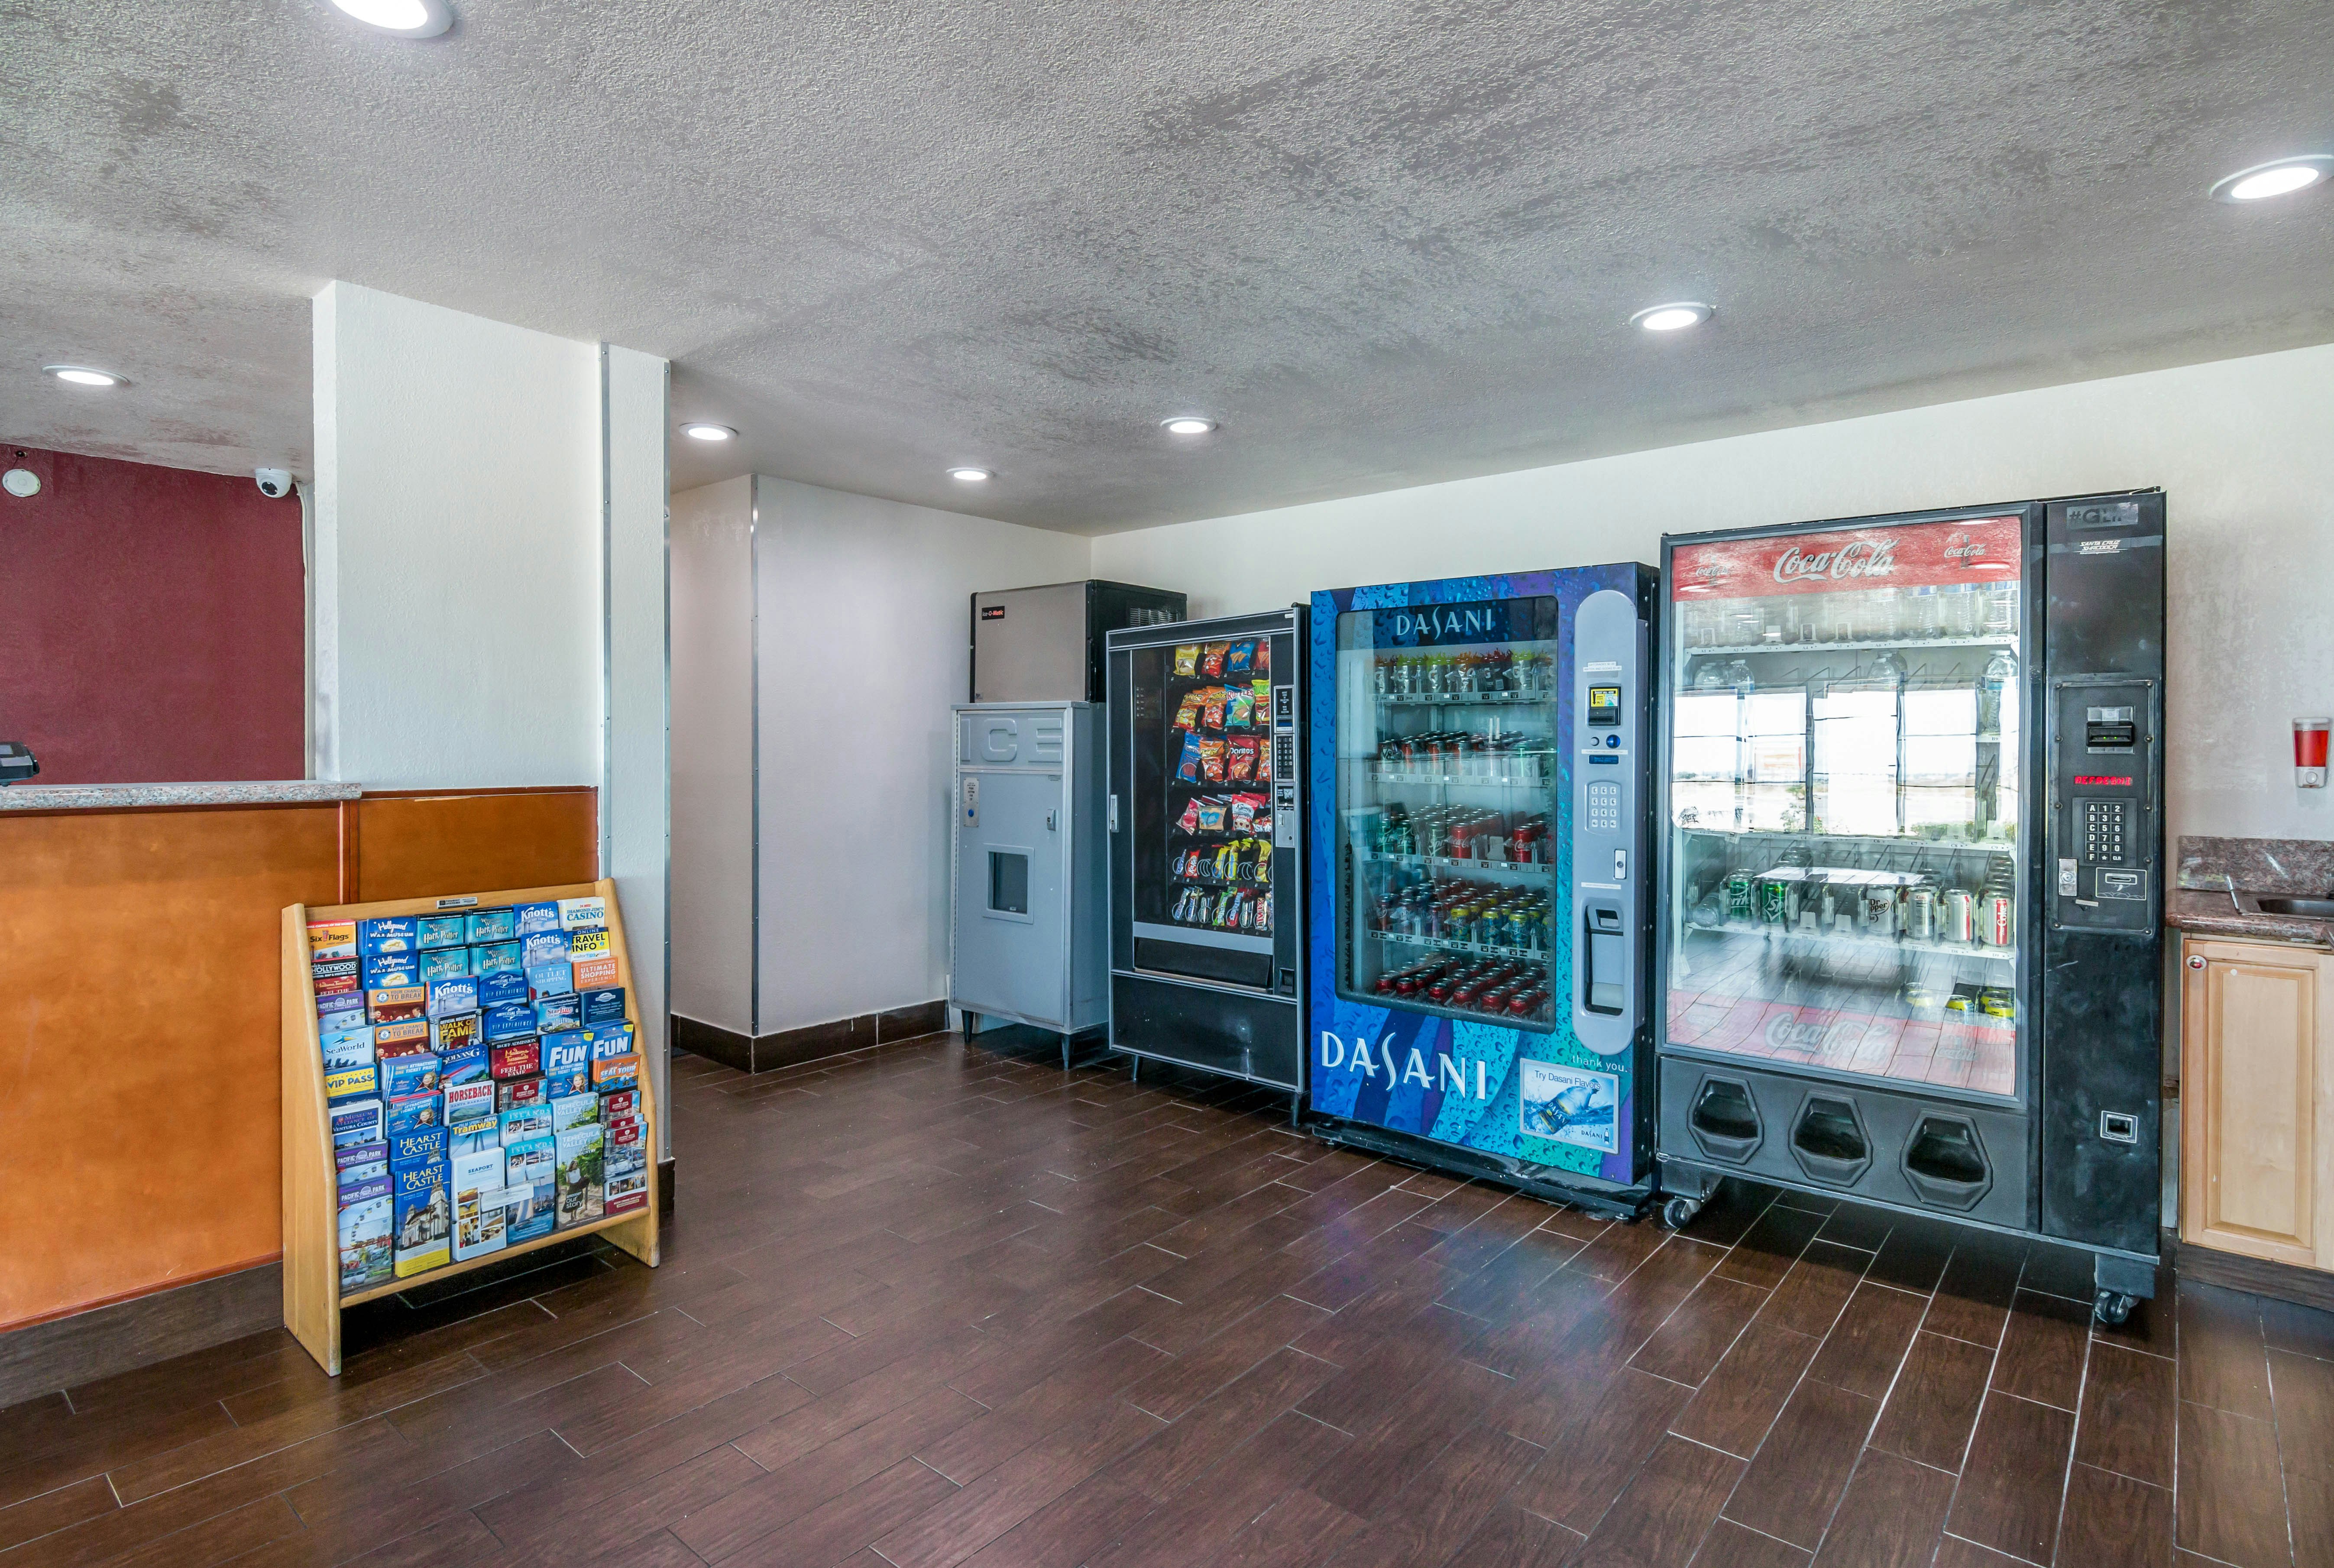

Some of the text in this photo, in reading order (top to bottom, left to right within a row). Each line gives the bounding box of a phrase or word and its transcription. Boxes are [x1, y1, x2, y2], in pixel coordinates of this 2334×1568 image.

[1944, 544, 1986, 557] Coca-Cola
[1773, 538, 1900, 583] Coca-Cola
[1396, 606, 1492, 639] DASANI
[961, 718, 1062, 762] ICE
[521, 906, 554, 922] Knott's
[567, 911, 603, 921] CASINO
[1997, 904, 2008, 927] Coke
[378, 920, 408, 933] Hollywood
[476, 925, 509, 938] Harry Potter
[424, 930, 458, 944] Harry Potter
[526, 933, 561, 950] Knott's
[572, 933, 605, 944] TRAVEL
[572, 943, 596, 952] INFO
[312, 963, 356, 973] HOLLYWOOD
[378, 956, 409, 968] Hollywood
[482, 956, 516, 970] Harry Potter
[581, 963, 615, 973] ULTIMATE
[427, 962, 463, 977] Harry Potter
[535, 970, 566, 979] OUTLET
[581, 969, 616, 979] SHOPPING
[581, 975, 615, 983] EXPERIENCE
[434, 982, 473, 999] Knott's
[496, 987, 524, 996] EXPERIENCE
[456, 1014, 476, 1022] HOLLYWOOD
[502, 1020, 532, 1029] EXPERIENCE
[440, 1021, 465, 1030] WALK
[440, 1025, 476, 1040] FAME
[326, 1042, 365, 1055] SeaWorld
[505, 1048, 529, 1057] Madame
[593, 1036, 628, 1059] FUN
[507, 1053, 529, 1062] Tussauds
[549, 1045, 587, 1067] FUN
[500, 1064, 518, 1074] FEEL
[618, 1065, 636, 1075] TOUR
[1322, 1031, 1486, 1100] DASANI
[1572, 1055, 1628, 1072] thank you.
[508, 1069, 526, 1078] FAME
[1534, 1070, 1602, 1090] Try Dasani Flavors.
[327, 1074, 374, 1089] VIP PASS
[449, 1085, 492, 1103] HORSEBACK
[557, 1098, 594, 1111] TEMECULA
[344, 1111, 372, 1121] MUSEUM
[509, 1109, 550, 1120] ISLANDS
[557, 1107, 582, 1116] VALLEY
[333, 1119, 378, 1132] VENTURA COUNTY
[453, 1119, 498, 1135] Tramway
[400, 1132, 443, 1148] HEARST
[563, 1130, 600, 1143] TEMECULA
[1581, 1130, 1602, 1139] DASANI
[403, 1141, 441, 1156] CASTLE
[511, 1140, 553, 1153] ISLANDS
[563, 1139, 588, 1148] VALLEY
[337, 1155, 355, 1164] PACIFIC
[403, 1164, 445, 1182] HEARST
[468, 1163, 493, 1173] SEAPORT
[406, 1173, 443, 1190] CASTLE
[341, 1192, 359, 1201] PACIFIC
[566, 1200, 583, 1209] story
